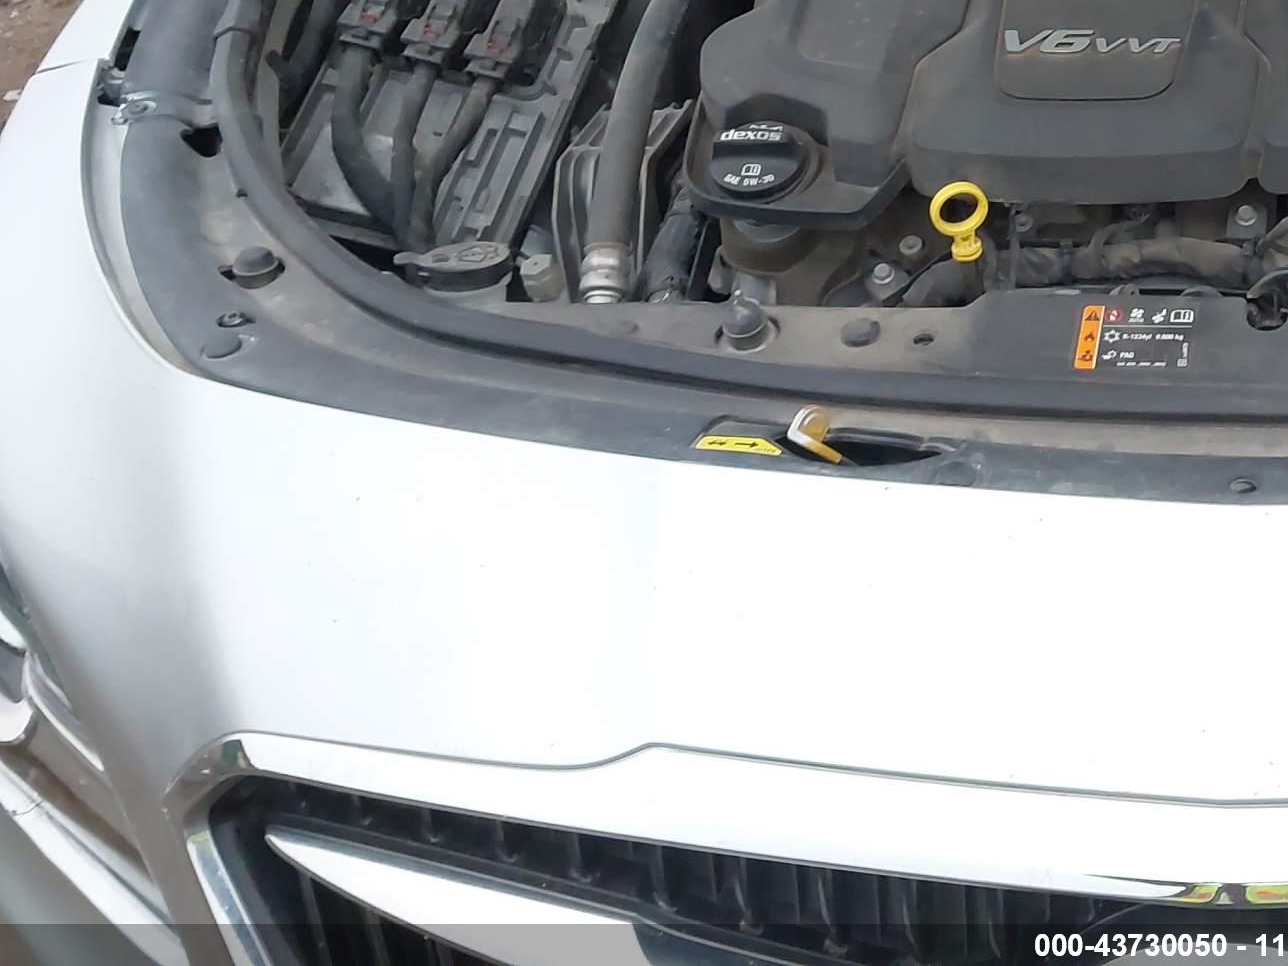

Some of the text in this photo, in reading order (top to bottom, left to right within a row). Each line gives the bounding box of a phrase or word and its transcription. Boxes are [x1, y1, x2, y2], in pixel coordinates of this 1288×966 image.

[1004, 29, 1182, 54] V6 VVT
[720, 129, 782, 141] dexos
[723, 174, 741, 186] SAE
